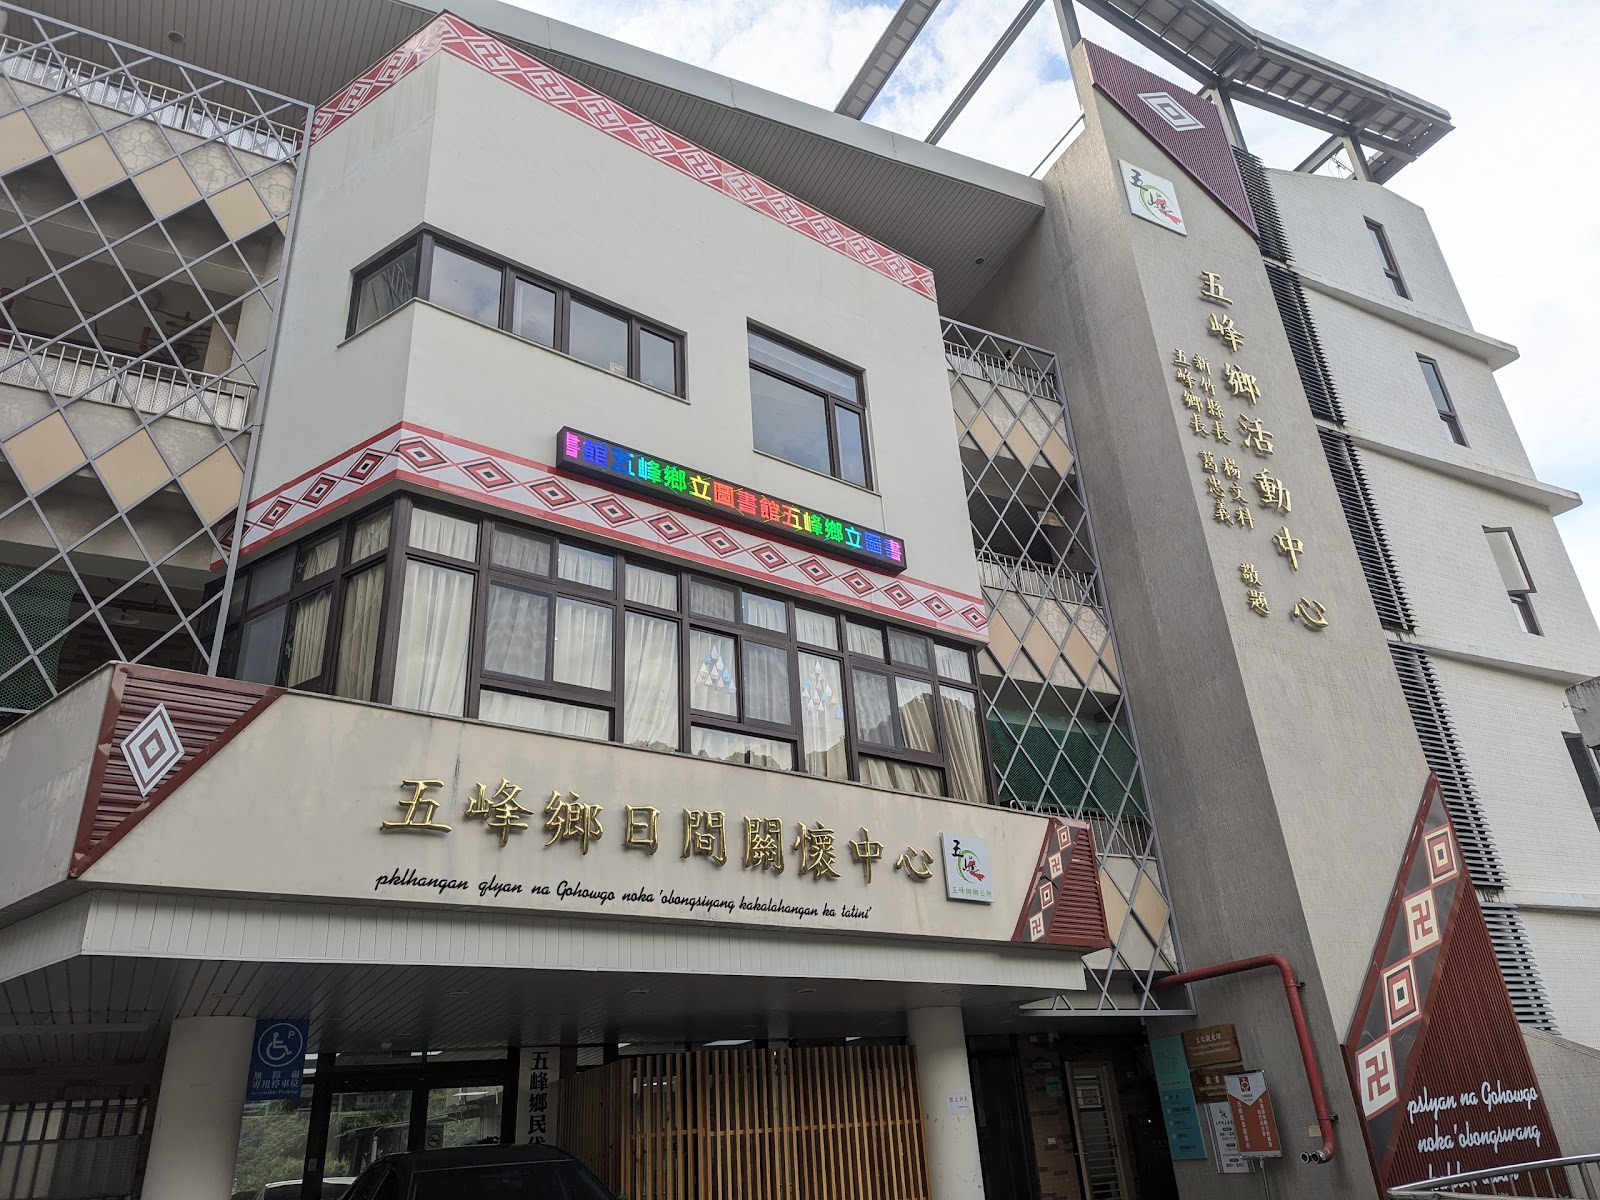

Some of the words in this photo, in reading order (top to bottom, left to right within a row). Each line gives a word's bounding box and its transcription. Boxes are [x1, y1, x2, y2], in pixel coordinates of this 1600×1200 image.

[1174, 348, 1210, 437] 五峰鄉長
[1198, 450, 1234, 525] 葛忠義
[1192, 353, 1231, 444] 新竹縣長
[1221, 456, 1255, 529] 楊文科
[1200, 270, 1328, 628] 五峰鄉活動中心
[1239, 562, 1271, 617] 敬題
[380, 777, 934, 885] 五峰鄉日間關懷中心
[374, 867, 469, 894] pklhangan
[531, 883, 551, 895] na
[556, 880, 616, 906] Gohowgo
[622, 887, 655, 903] noka
[739, 896, 818, 919] kakalahangan
[822, 903, 836, 917] ka
[288, 1030, 296, 1039] P
[252, 1078, 300, 1089] 專用停車位
[253, 1069, 301, 1081] 無障礙
[1460, 1089, 1478, 1106] na
[1481, 1080, 1538, 1112] Gohowgo
[1417, 1124, 1454, 1153] noka
